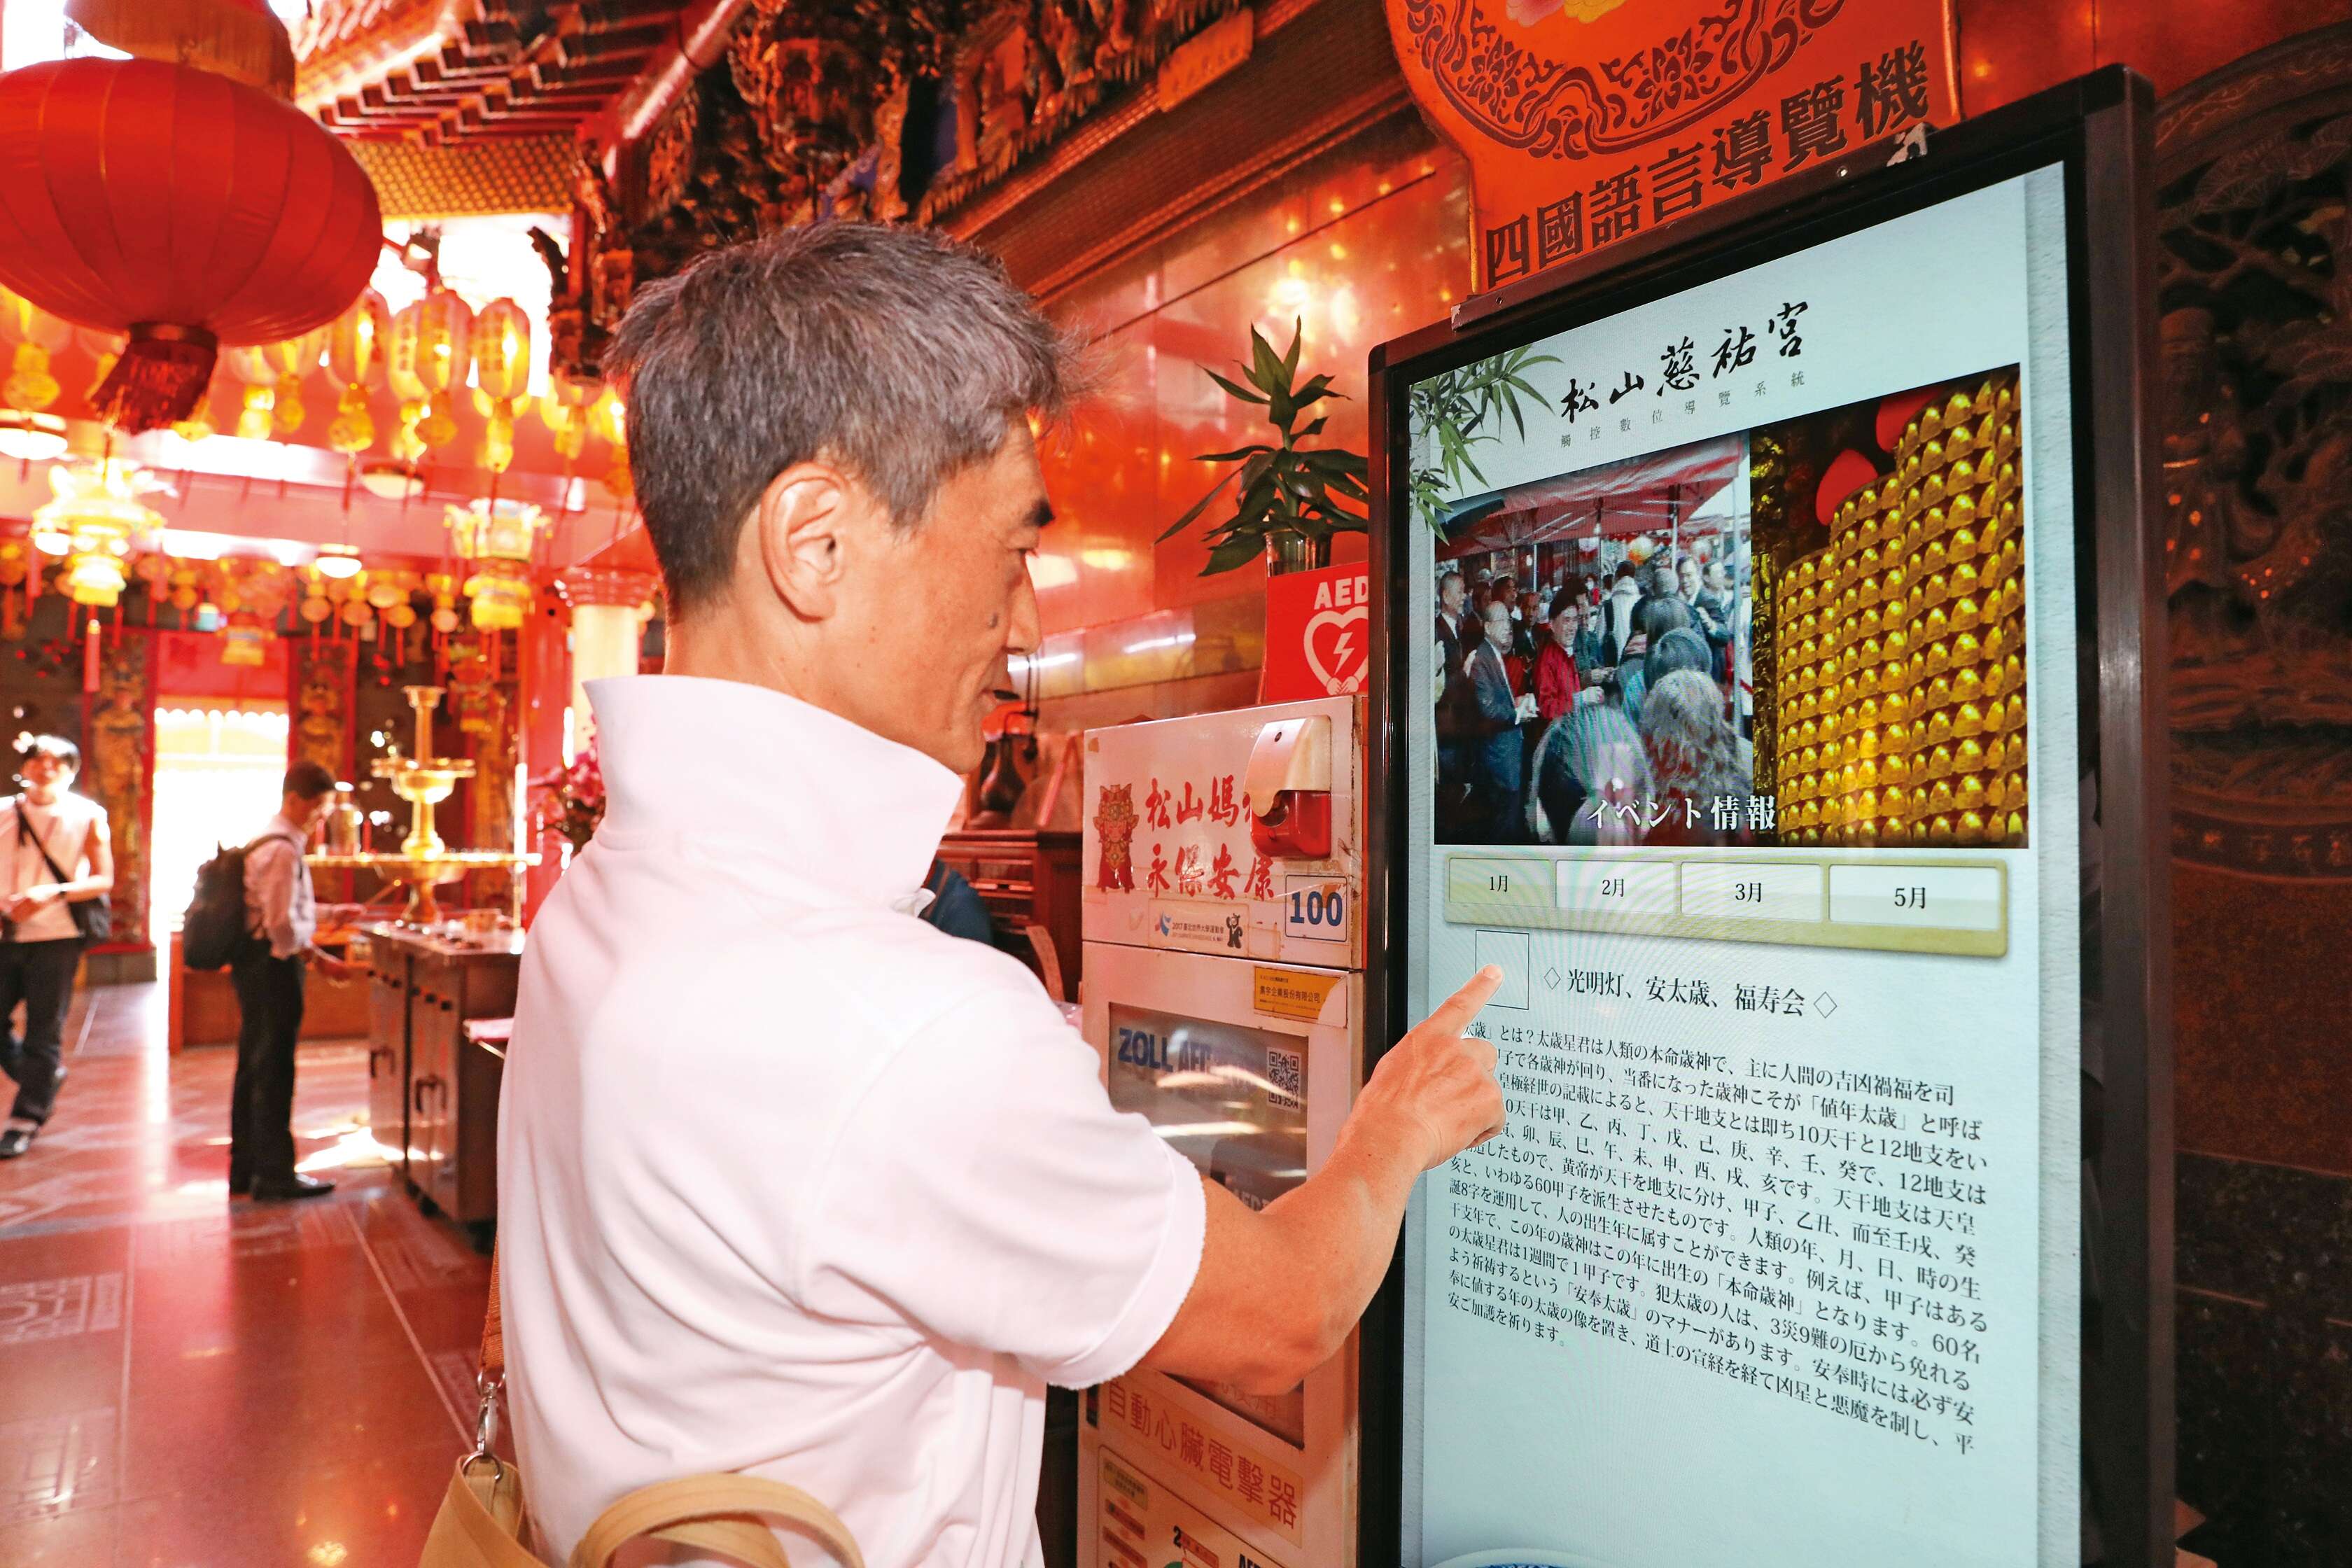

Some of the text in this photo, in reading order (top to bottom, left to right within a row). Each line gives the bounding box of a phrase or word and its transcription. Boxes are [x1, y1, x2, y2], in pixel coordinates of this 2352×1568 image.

[1486, 39, 1929, 288] 四國語言導覽機
[1560, 301, 1809, 424] 松山慈祐宮
[1314, 575, 1368, 610] AED
[1145, 774, 1251, 832] 松山媽
[1587, 795, 1776, 831] イベント情報
[1489, 875, 1508, 892] 1月
[1602, 878, 1625, 897] 2月
[1735, 882, 1763, 904] 3月
[1893, 886, 1927, 910] 5月
[1290, 891, 1343, 926] 100
[1118, 1027, 1173, 1072] ZOLL
